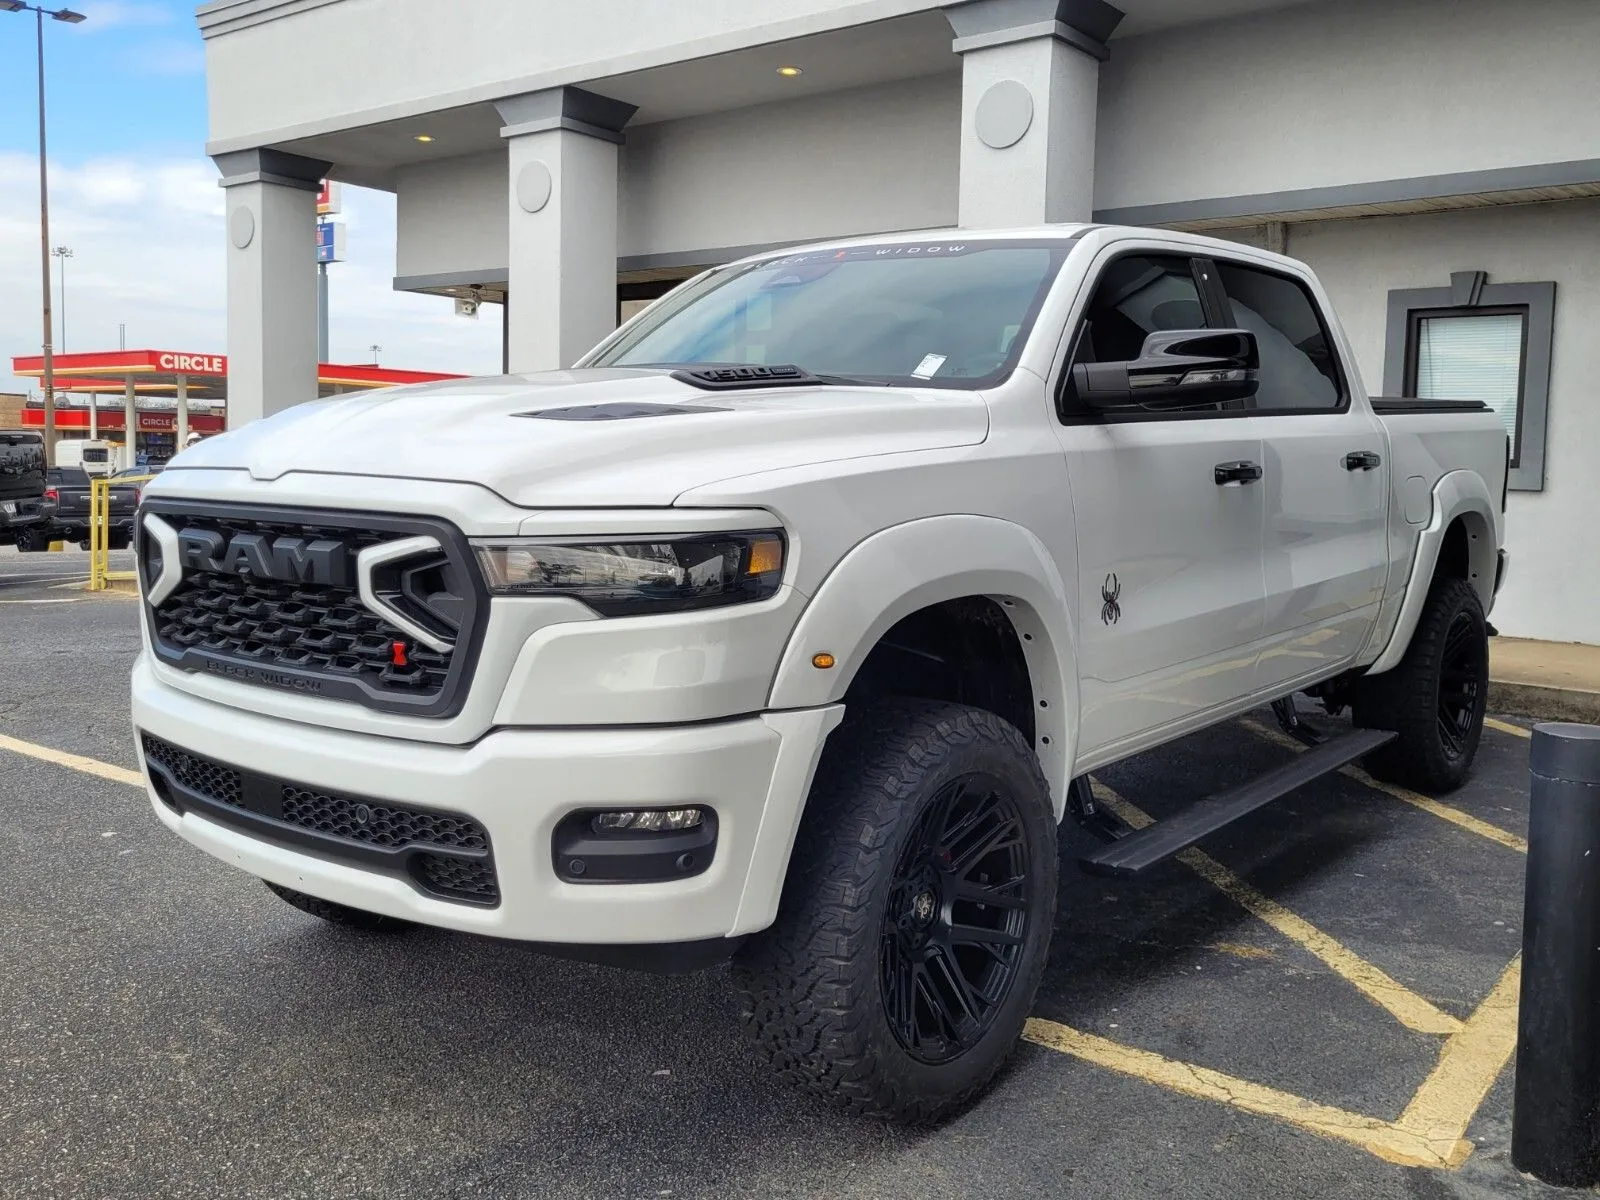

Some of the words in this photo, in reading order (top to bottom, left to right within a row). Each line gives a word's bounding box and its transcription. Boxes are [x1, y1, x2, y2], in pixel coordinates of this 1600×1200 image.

[875, 245, 966, 256] WIDOW
[160, 353, 223, 373] CIRCLE
[142, 418, 171, 426] CIRCLE
[178, 527, 345, 585] RAM
[261, 671, 321, 692] WIDOW
